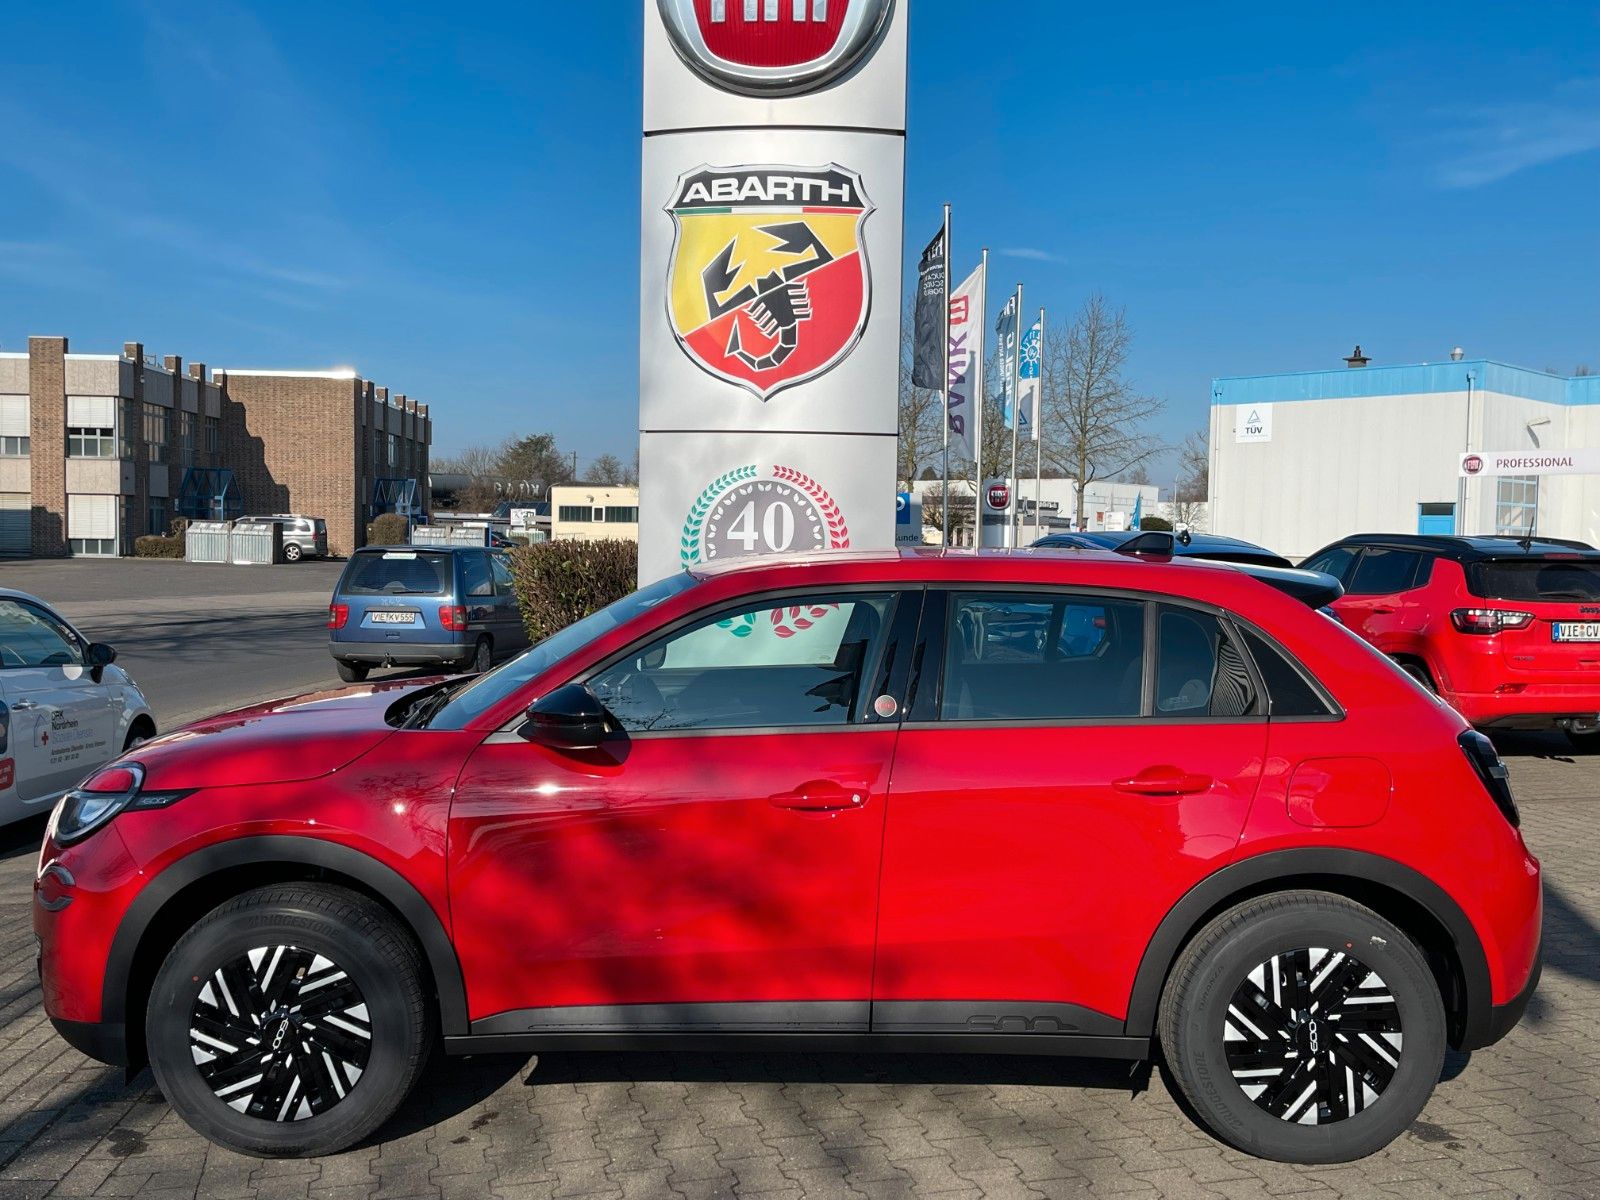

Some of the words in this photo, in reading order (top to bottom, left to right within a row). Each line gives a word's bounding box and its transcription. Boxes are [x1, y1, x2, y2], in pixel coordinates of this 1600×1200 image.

[682, 176, 850, 203] ABARTH
[1246, 425, 1263, 434] TÜV
[1496, 457, 1573, 468] PROFESSIONAL
[727, 500, 795, 552] 40
[896, 534, 919, 542] unde
[1560, 625, 1579, 637] VIE
[1586, 625, 1599, 637] CV
